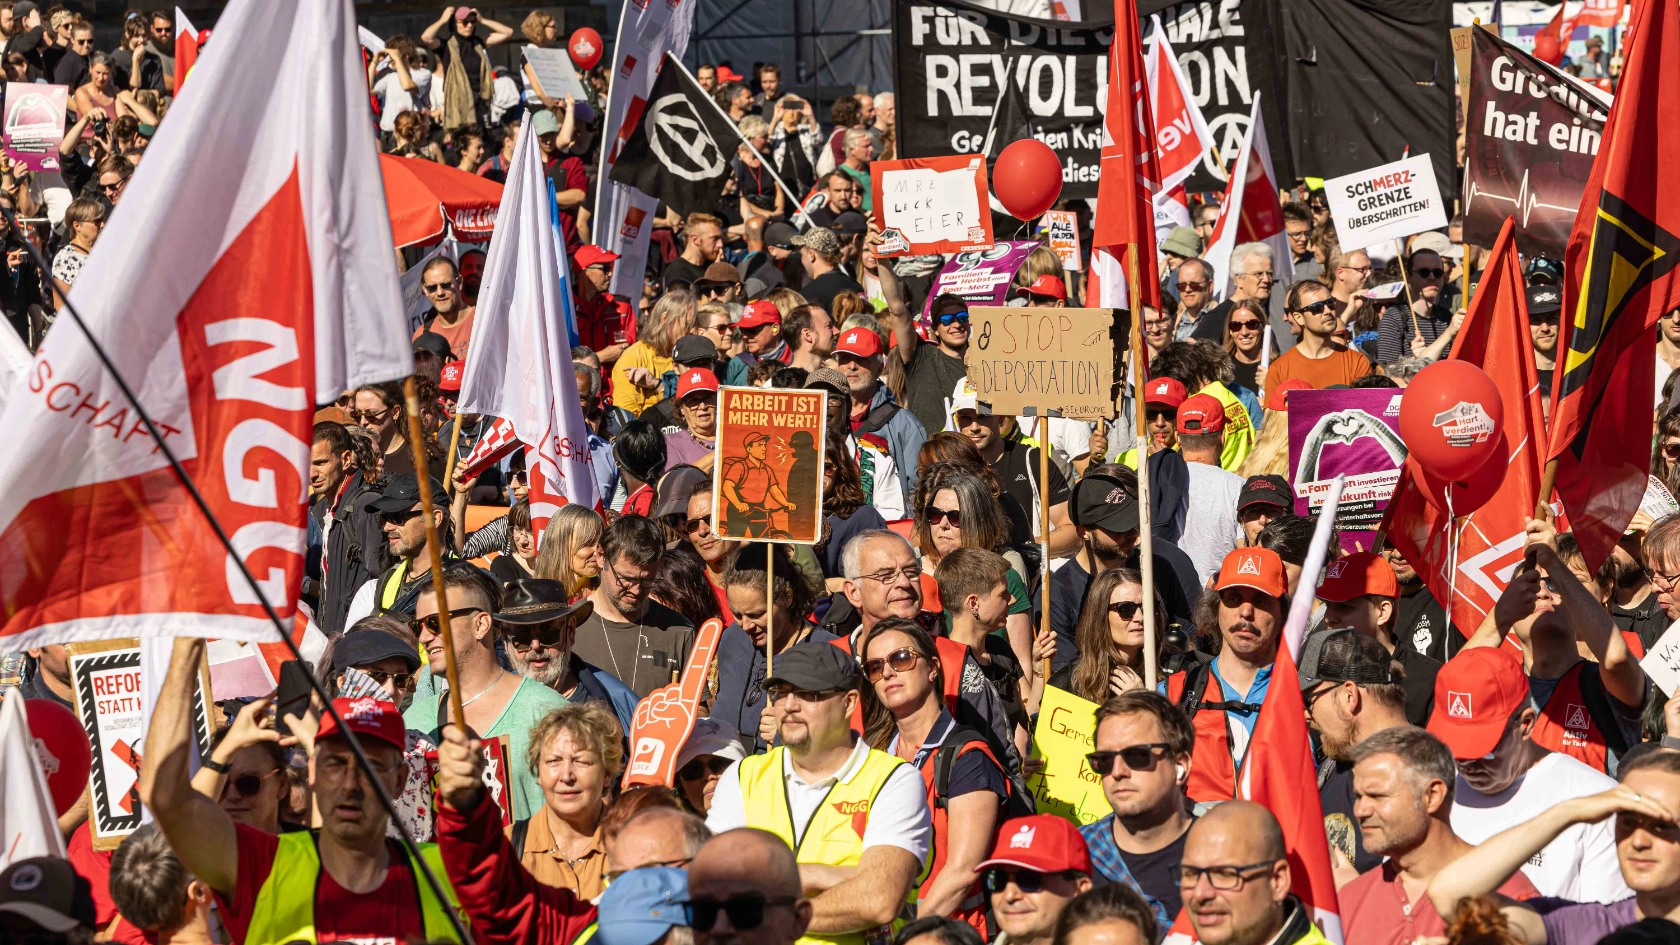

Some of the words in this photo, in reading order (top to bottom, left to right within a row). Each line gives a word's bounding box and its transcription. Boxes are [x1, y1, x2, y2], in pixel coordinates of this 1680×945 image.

[911, 6, 991, 46] FÜR
[1483, 101, 1541, 145] hat
[1062, 156, 1102, 183] dies
[1346, 170, 1416, 199] SCHMERZ-
[894, 197, 932, 213] LECK
[1357, 187, 1412, 211] GRENZE
[456, 209, 475, 228] DIE
[914, 211, 964, 233] EIER
[1050, 213, 1070, 223] WIR
[1348, 199, 1430, 230] ÜBERSCHRITTEN!
[1050, 222, 1071, 231] ALLE
[944, 271, 989, 281] Familien-
[961, 276, 991, 284] Herbst
[943, 284, 990, 294] Spar-Merz
[1003, 314, 1073, 353] STOP
[982, 360, 1099, 396] DEPORTATION
[729, 394, 788, 412] ARBEIT
[792, 396, 817, 413] IST
[728, 411, 769, 427] MEHR
[772, 413, 817, 429] WERT!
[1445, 423, 1486, 434] verdient!
[1459, 416, 1478, 425] Hart
[1340, 490, 1377, 502] ukunft
[94, 672, 141, 697] REFOR
[99, 698, 133, 715] STATT
[1563, 730, 1588, 740] Aktiv
[1035, 772, 1064, 808] Für
[841, 801, 868, 814] NGG
